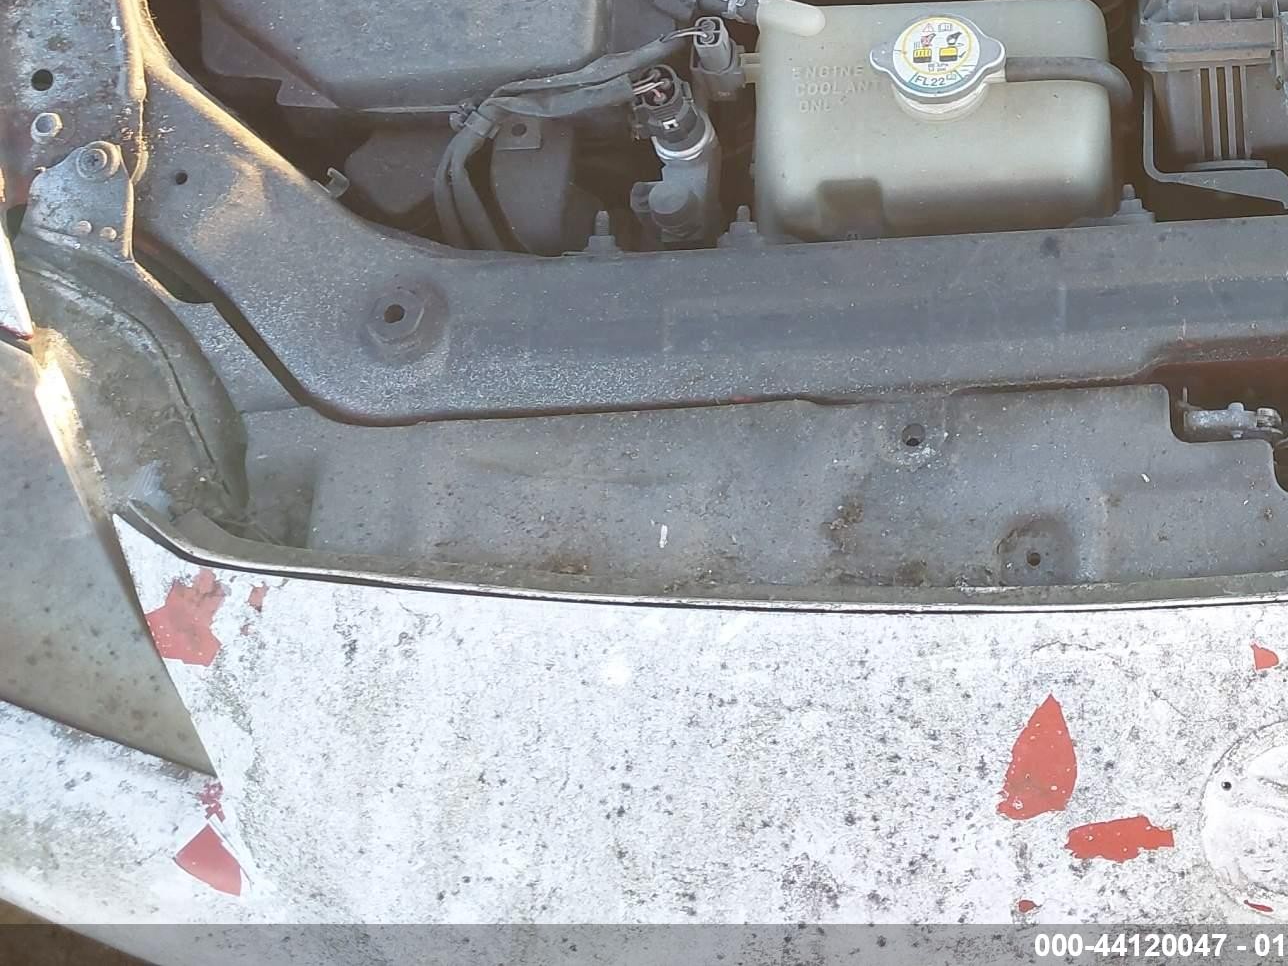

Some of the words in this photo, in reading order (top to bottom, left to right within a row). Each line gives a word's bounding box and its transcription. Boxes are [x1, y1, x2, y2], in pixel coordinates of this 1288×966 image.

[792, 66, 864, 80] ENGINE
[914, 75, 946, 86] FL22
[796, 80, 881, 96] COOLANT
